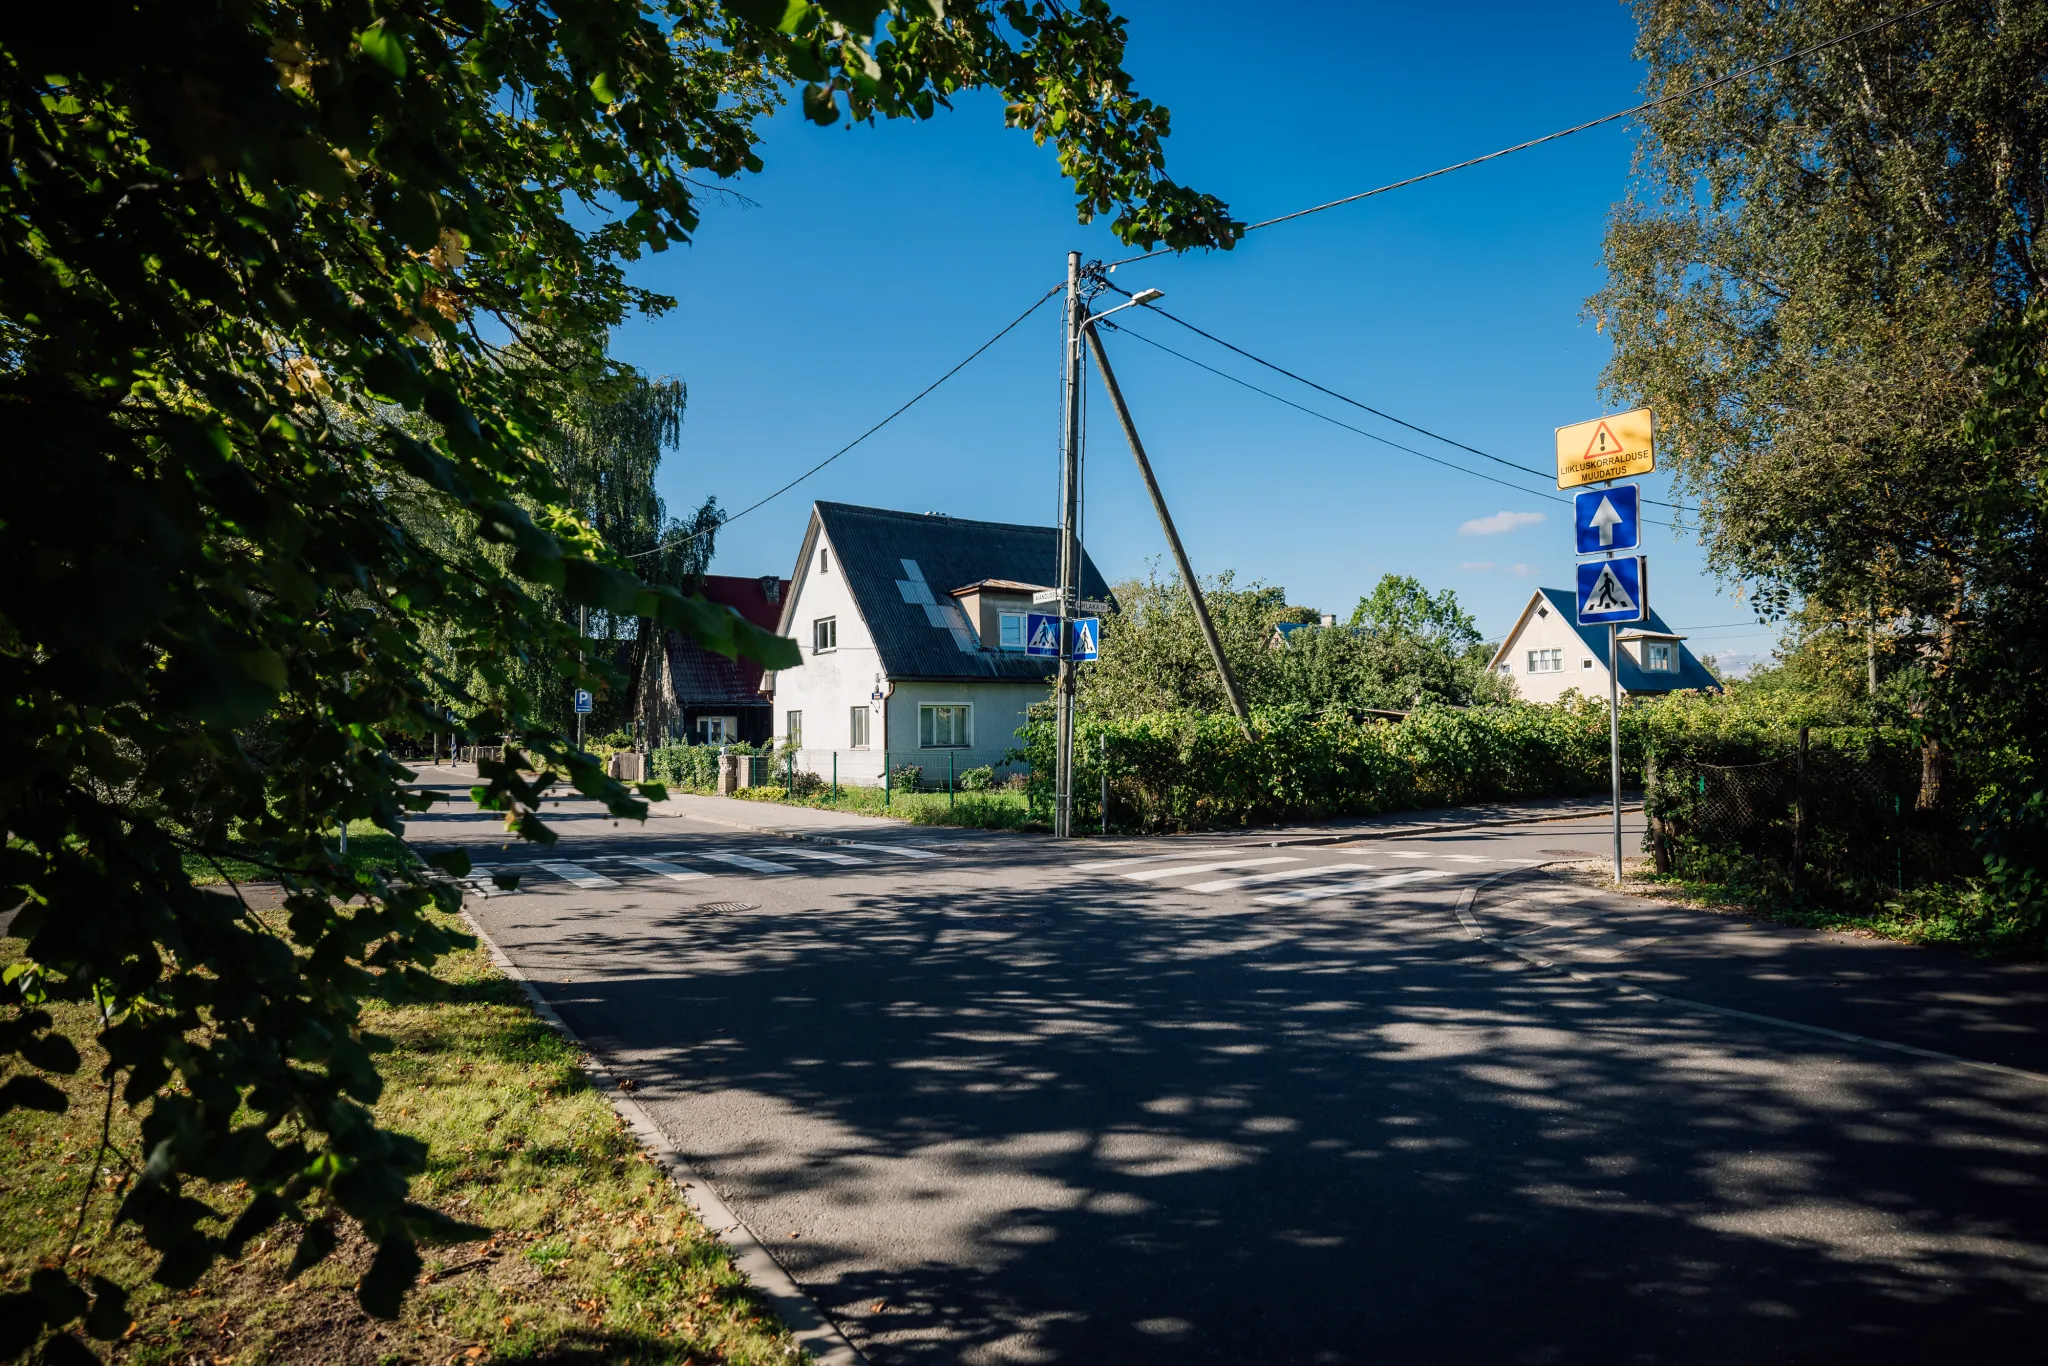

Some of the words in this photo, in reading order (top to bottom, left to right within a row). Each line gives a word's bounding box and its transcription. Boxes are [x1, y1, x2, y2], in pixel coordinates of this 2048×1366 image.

[1560, 449, 1649, 475] LIIKLUSKORRALDUSE
[1581, 465, 1627, 482] MUUDATUS
[579, 691, 588, 705] P
